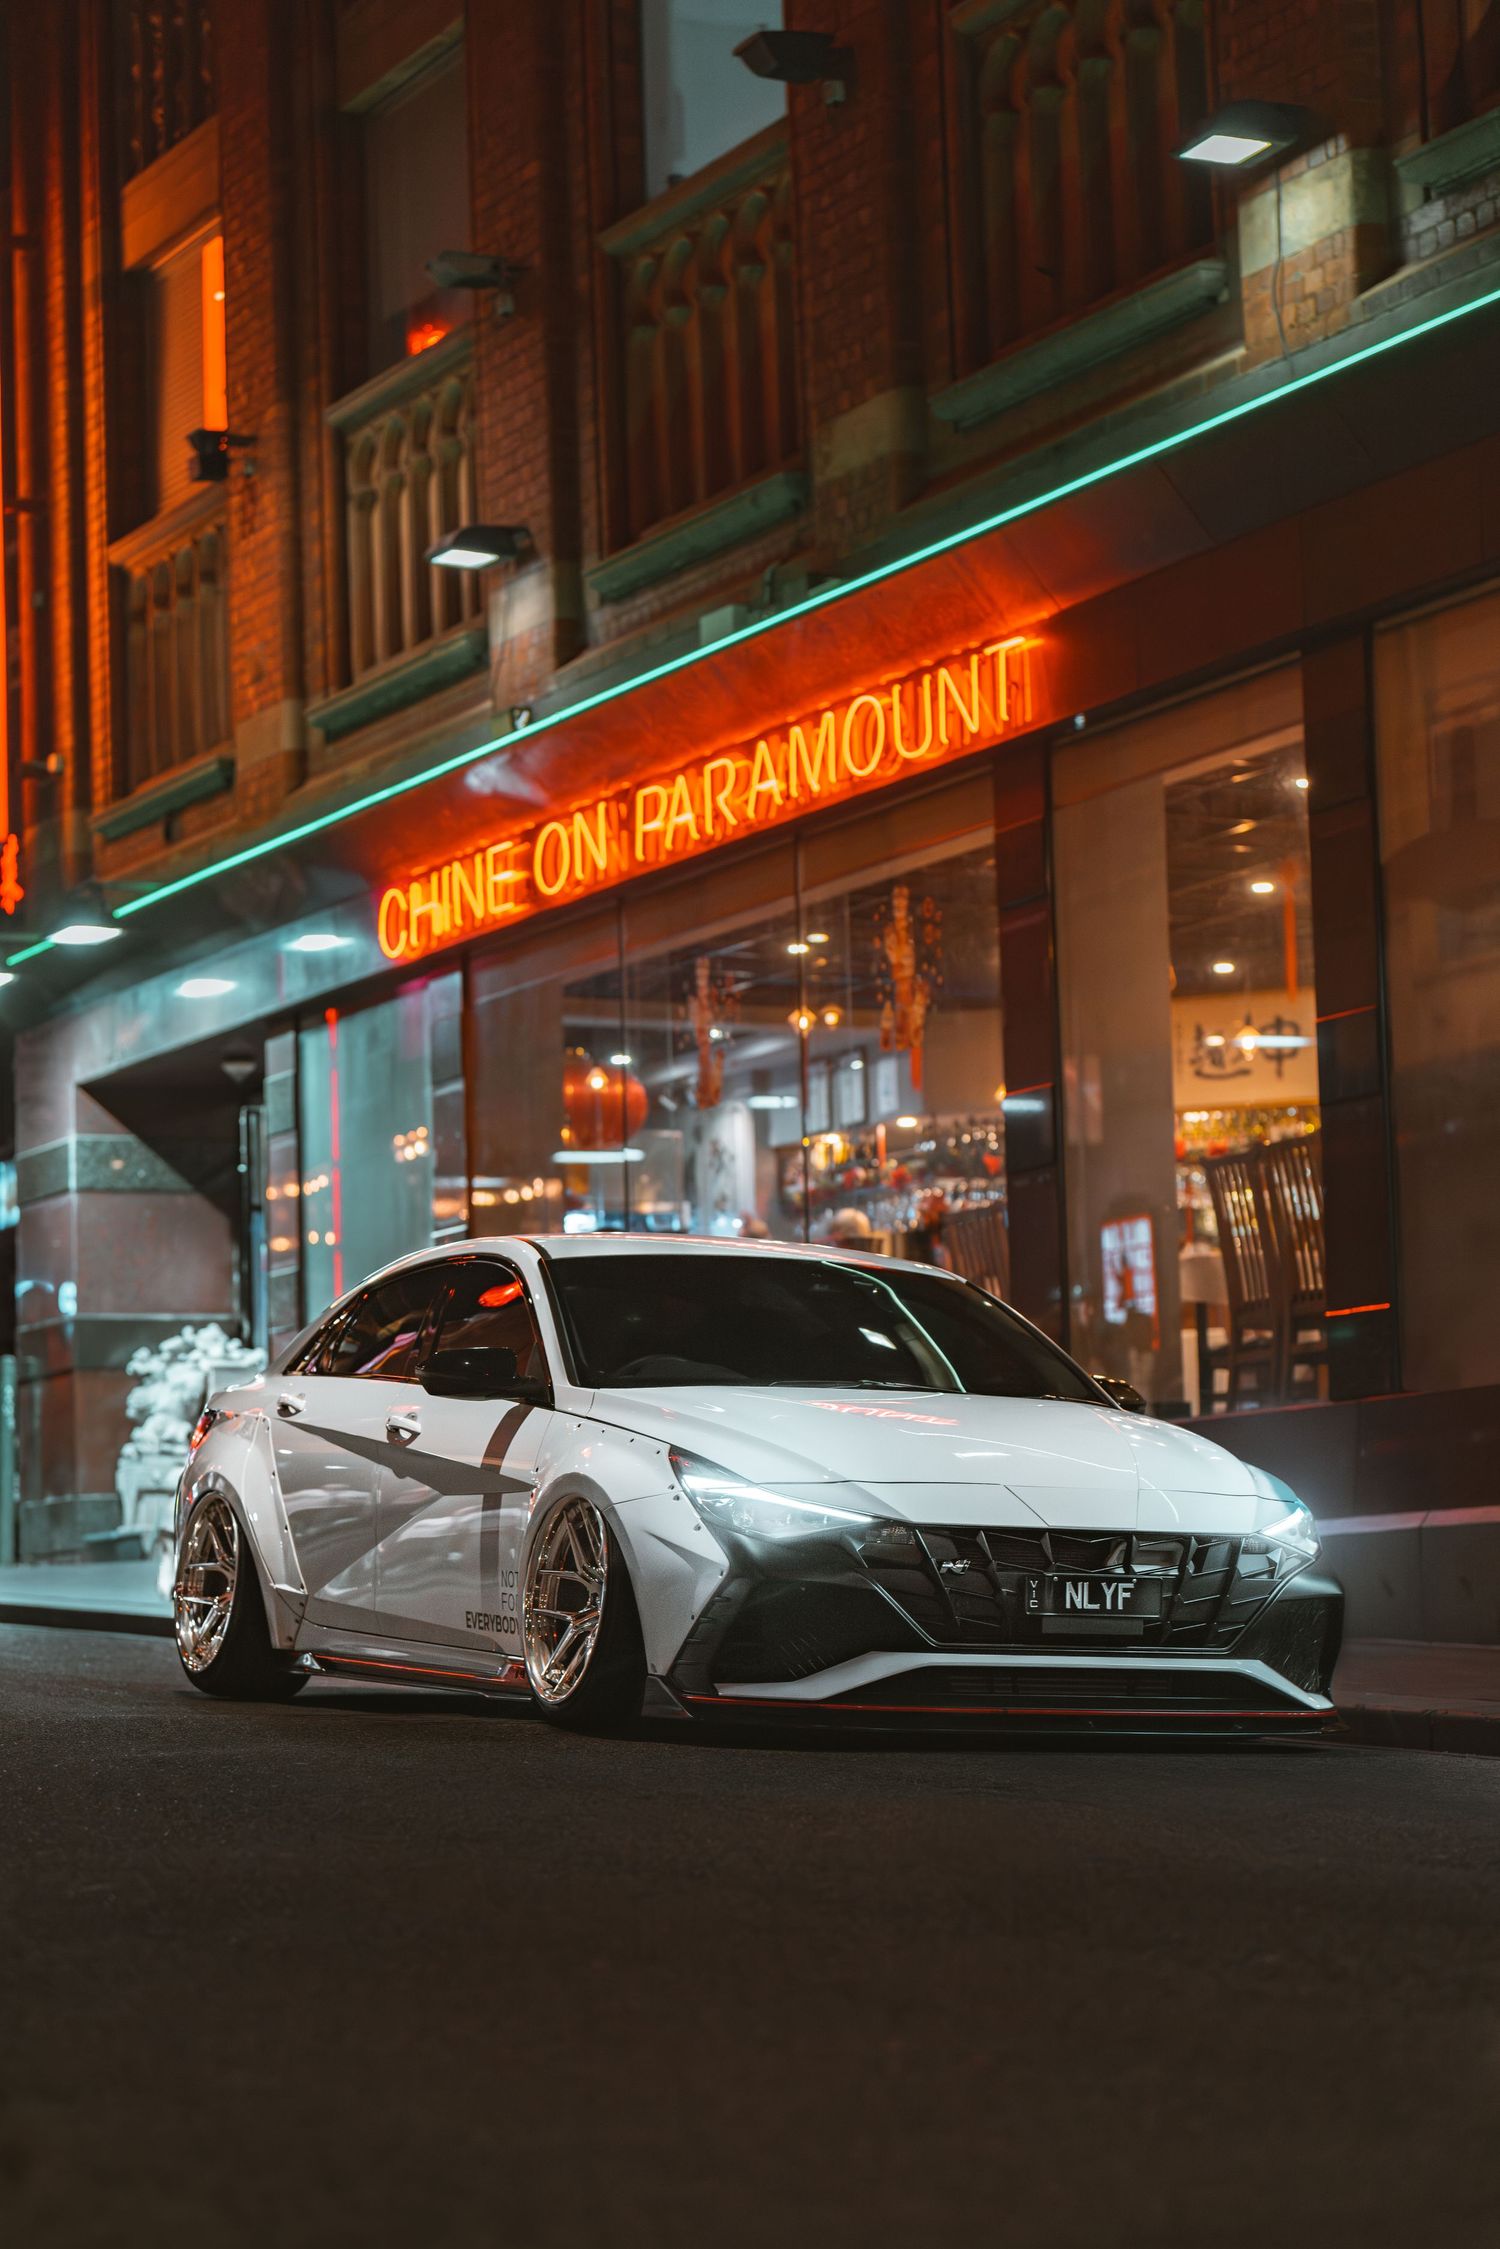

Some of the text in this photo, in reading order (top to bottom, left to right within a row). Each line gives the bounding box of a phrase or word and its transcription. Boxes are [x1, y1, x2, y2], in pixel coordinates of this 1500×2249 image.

[376, 634, 1028, 961] CHINE ON PARAMOUNT
[501, 1592, 519, 1611] FO
[1029, 1580, 1039, 1608] VIC
[1065, 1581, 1135, 1610] NLYF
